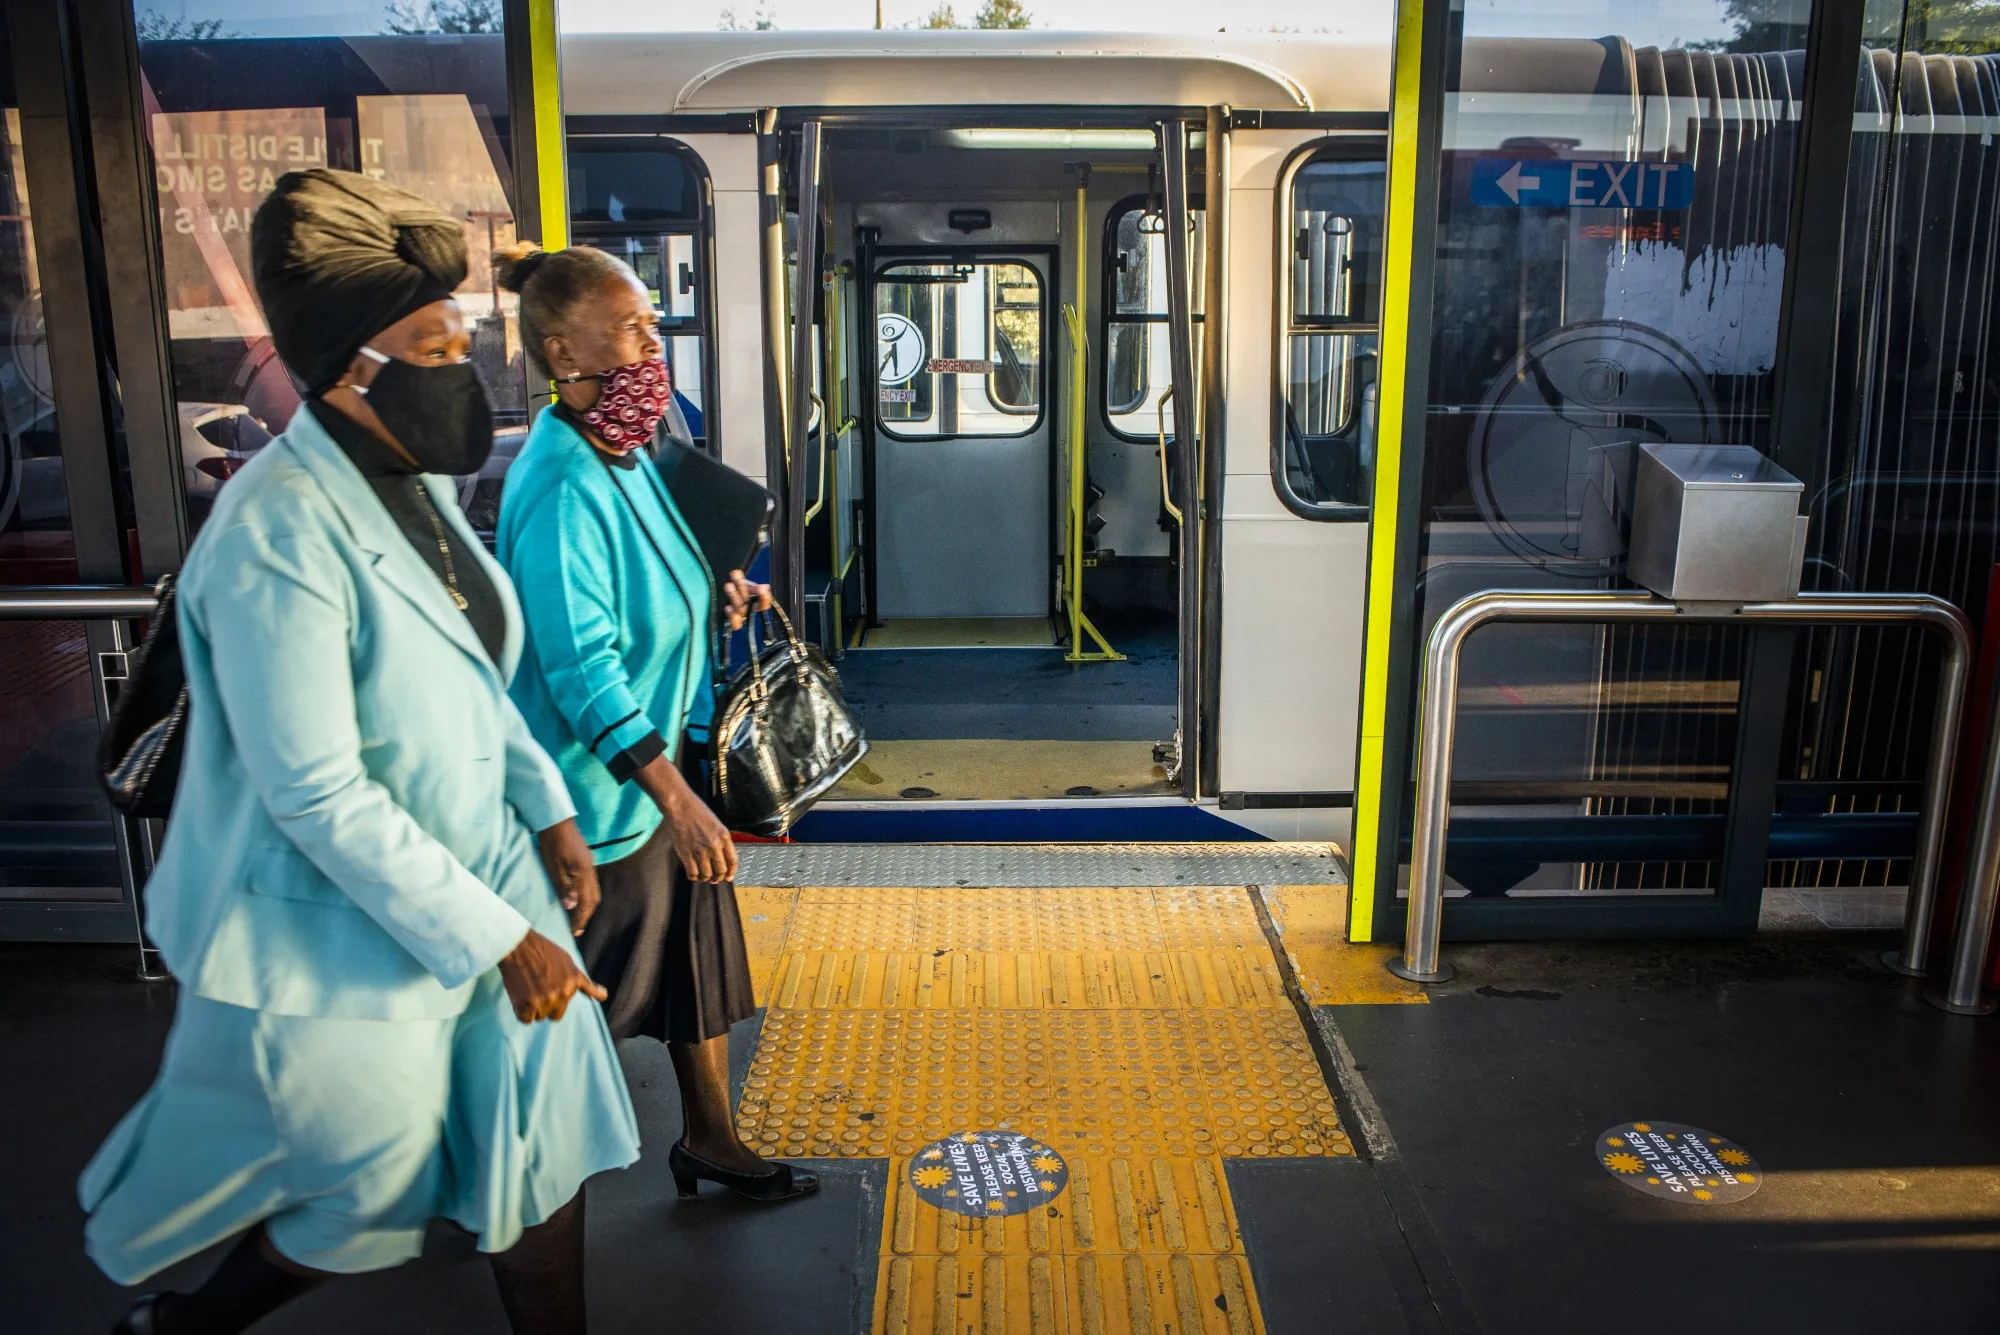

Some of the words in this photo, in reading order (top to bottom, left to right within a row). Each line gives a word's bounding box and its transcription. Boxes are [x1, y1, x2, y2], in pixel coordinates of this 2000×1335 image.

[1568, 162, 1679, 207] EXIT
[900, 390, 915, 401] EXIT
[948, 1143, 971, 1172] LIVES
[972, 1143, 988, 1163] KEEP
[1624, 1131, 1660, 1161] LIVES
[1648, 1133, 1674, 1154] KEEP
[1676, 1143, 1712, 1175] SOCIAL
[1683, 1133, 1739, 1185] DISTANCING
[981, 1164, 1002, 1198] PLEASE
[995, 1152, 1016, 1185] SOCIAL
[1007, 1141, 1039, 1194] DISTANCING
[1651, 1163, 1688, 1193] SAVE
[1667, 1154, 1705, 1187] PLEASE
[958, 1174, 982, 1206] SAVE
